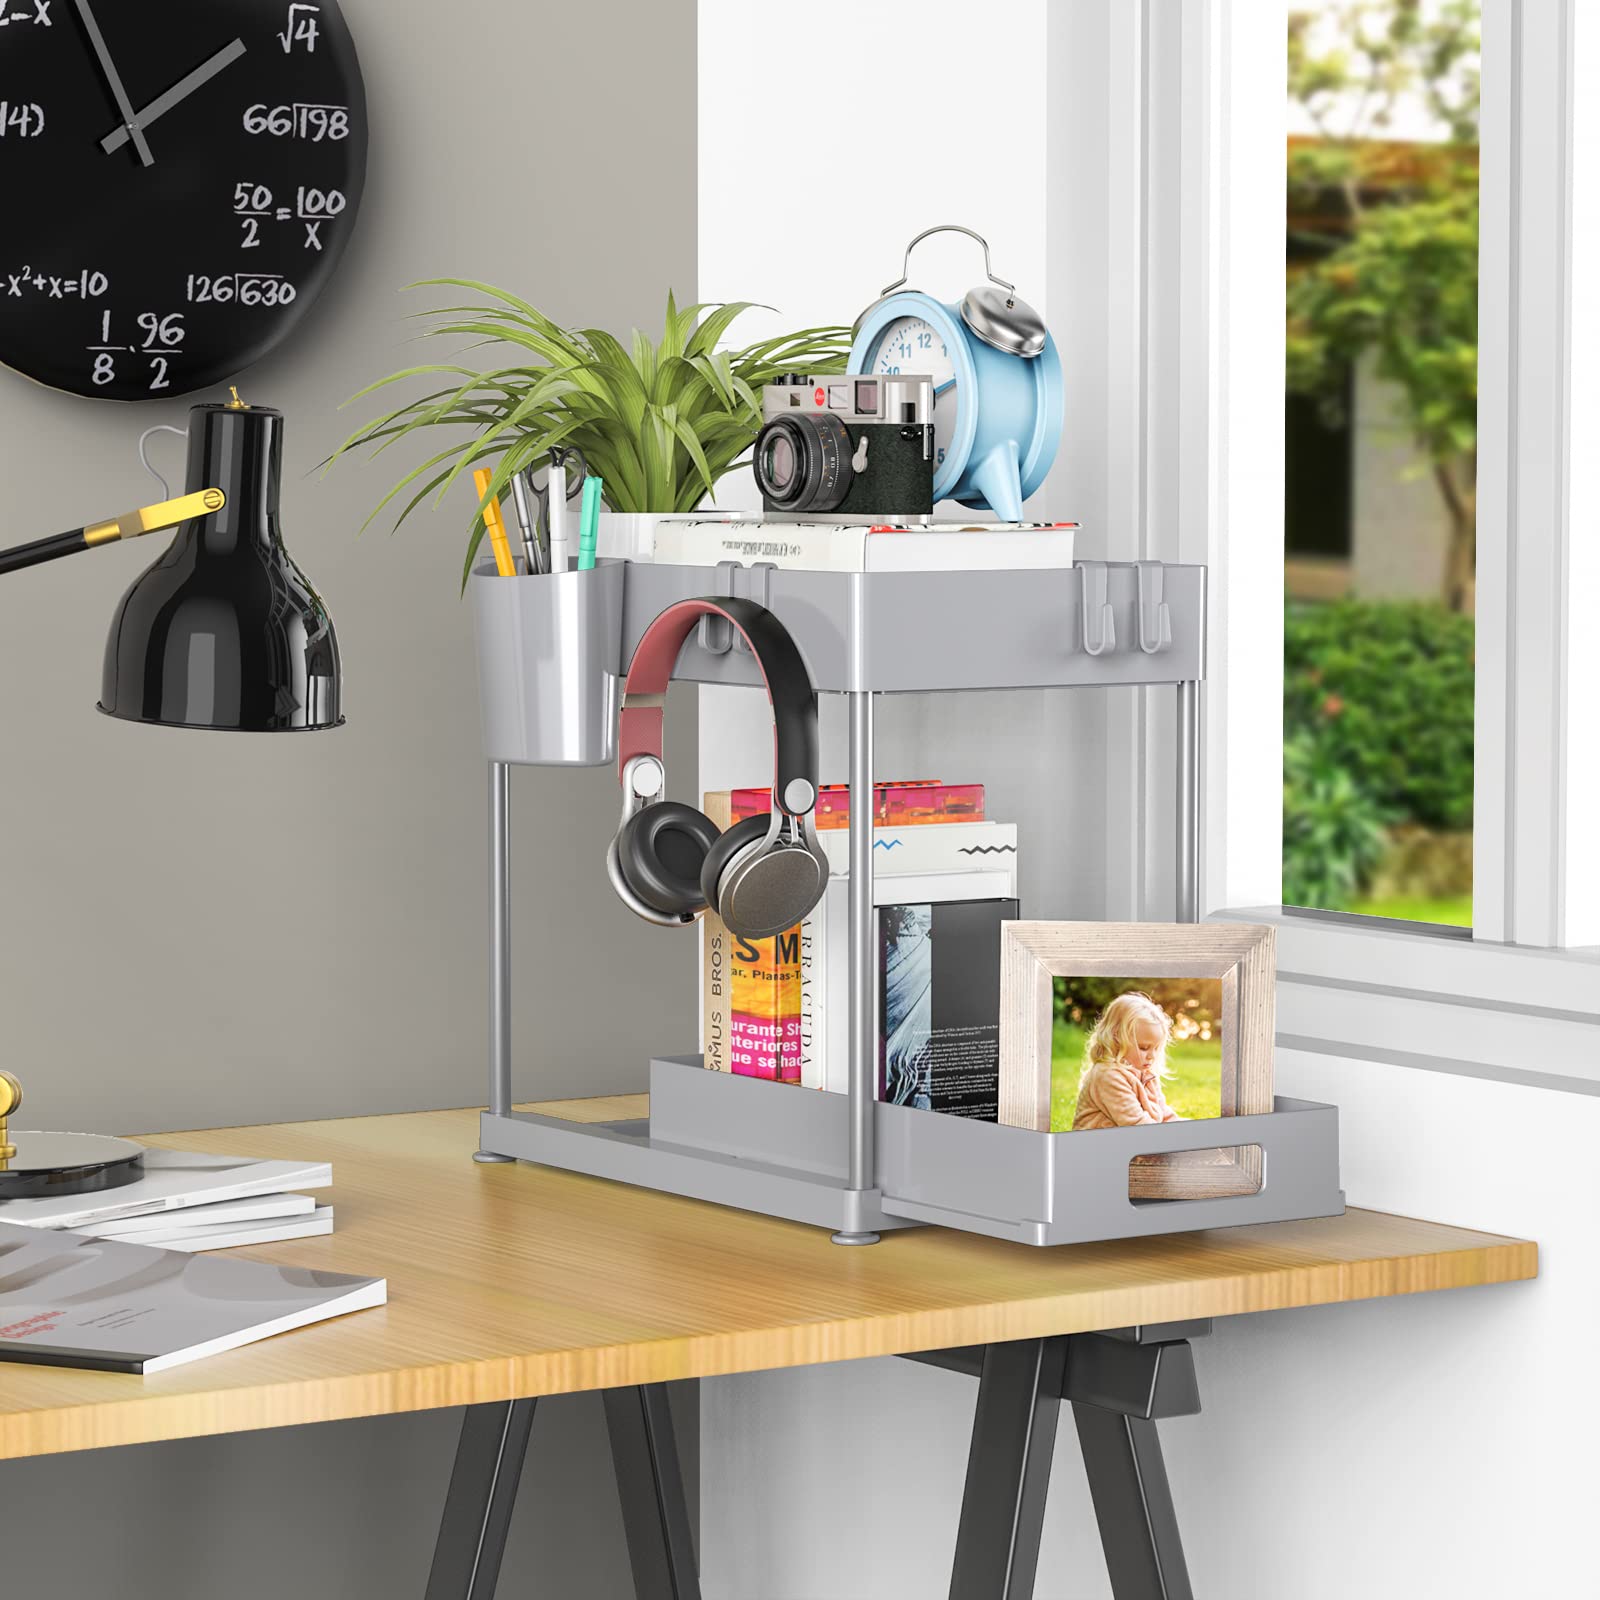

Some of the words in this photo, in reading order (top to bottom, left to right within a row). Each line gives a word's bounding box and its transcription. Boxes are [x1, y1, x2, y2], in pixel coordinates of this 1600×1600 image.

[234, 182, 272, 210] 50
[297, 186, 346, 215] 100
[241, 219, 260, 248] 2
[137, 312, 185, 348] 96
[917, 333, 932, 349] 12
[898, 343, 912, 359] 11
[941, 343, 948, 358] 1
[92, 353, 115, 384] 8
[150, 357, 170, 389] 2
[937, 447, 946, 465] 5
[757, 1056, 777, 1069] se
